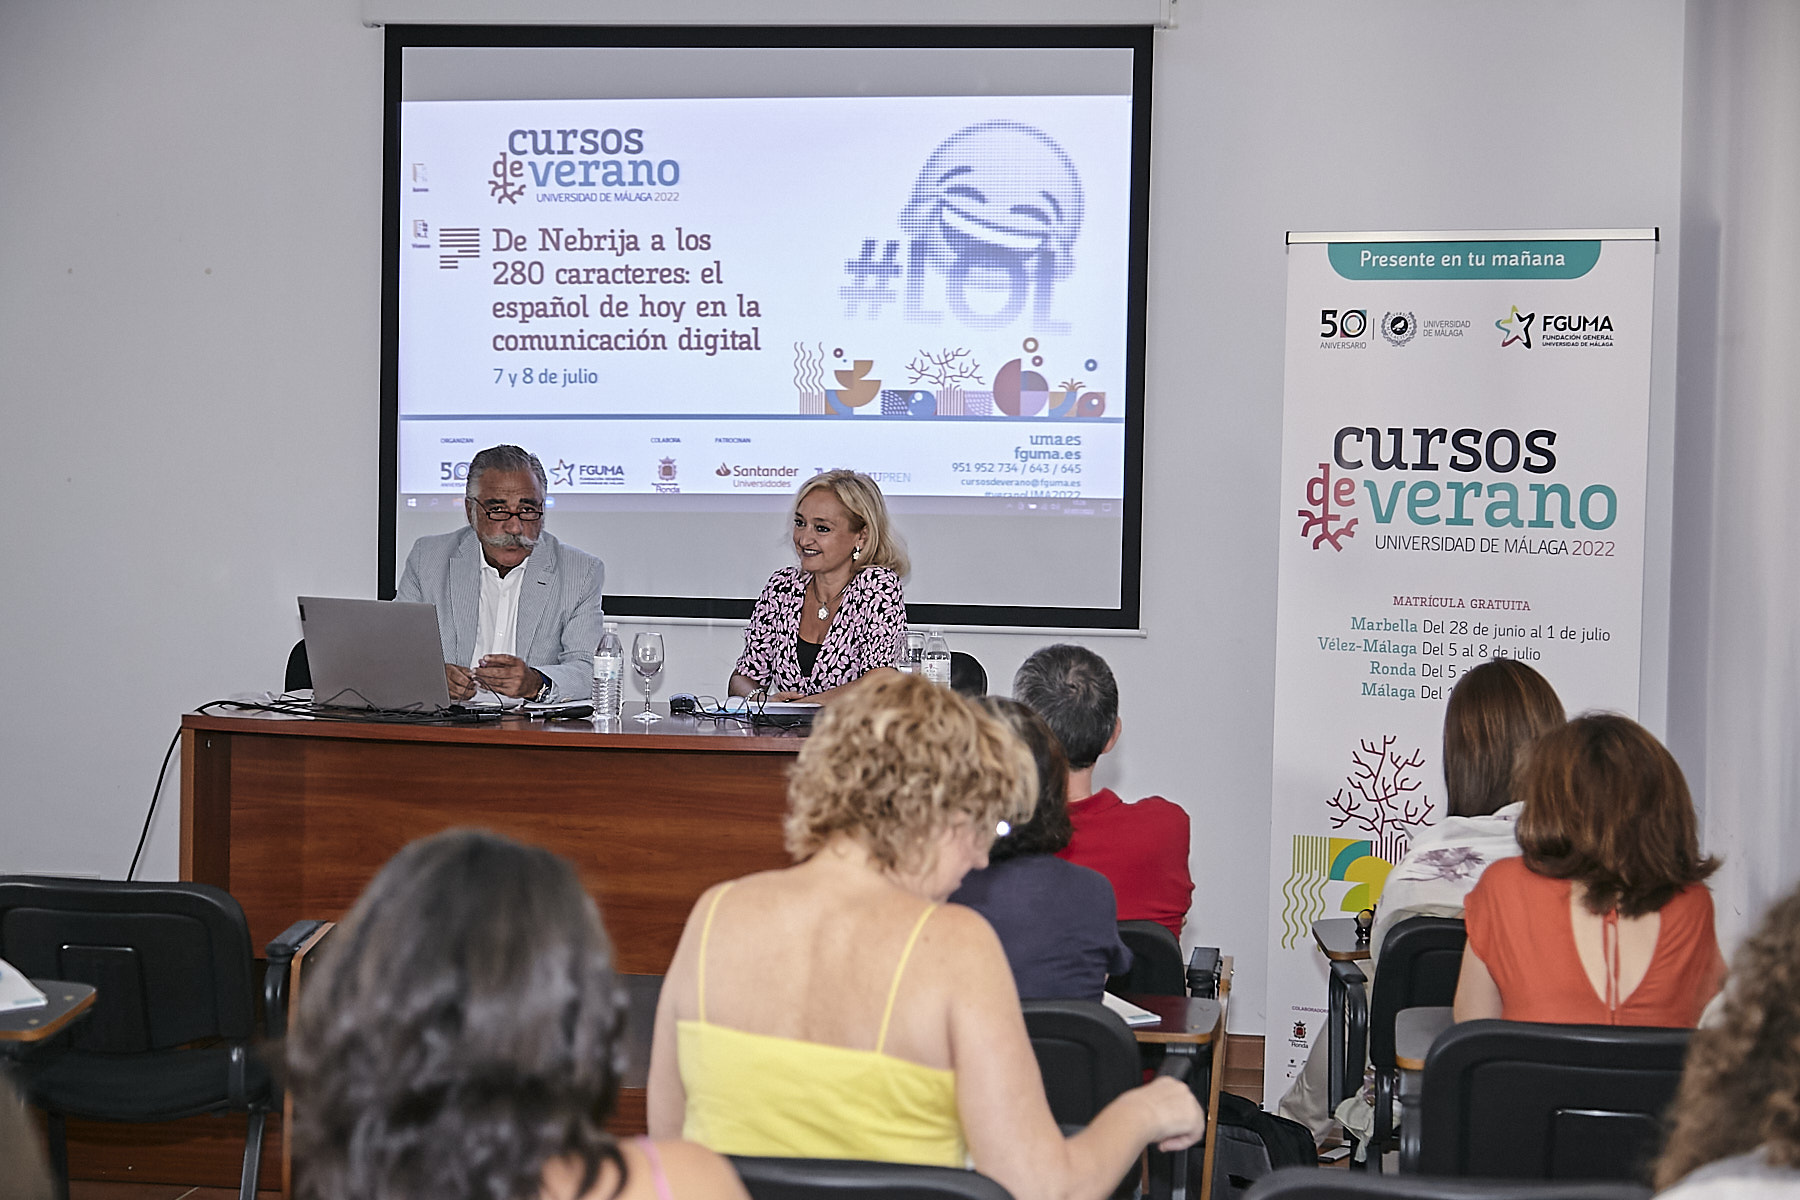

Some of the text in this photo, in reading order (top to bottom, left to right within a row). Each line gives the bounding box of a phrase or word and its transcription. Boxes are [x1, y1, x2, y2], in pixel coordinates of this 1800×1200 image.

[508, 128, 644, 156] cursos
[493, 152, 680, 187] de verano
[536, 191, 679, 202] UNIVERSIDAD DE MÁLAGA 2022
[493, 227, 712, 257] De Nebrija a los
[1360, 250, 1566, 267] Presente en tu mañana
[493, 260, 723, 285] 280 caracteres: el
[492, 294, 762, 323] español de hoy en la
[1320, 309, 1367, 338] 50
[1423, 320, 1471, 328] UNIVERSIDAD
[1543, 315, 1614, 331] FGUMA
[492, 327, 762, 356] comunicación digital
[1434, 328, 1463, 337] MÁLAGA
[1320, 341, 1367, 350] ANIVERSARIO
[493, 367, 598, 388] 7 y 8 de julio
[1014, 447, 1081, 462] fguma.es
[1333, 426, 1558, 474] cursos
[579, 465, 624, 476] FGUMA
[733, 465, 799, 477] Santander
[952, 462, 971, 473] 951
[974, 462, 994, 473] 952
[998, 463, 1018, 473] 734
[1029, 463, 1049, 473] 643
[1061, 464, 1081, 473] 645
[733, 479, 791, 488] Universidades
[961, 478, 1081, 488] cursosdeverano@fguma.es
[1306, 463, 1618, 531] de verano
[1375, 535, 1615, 557] UNIVERSIDAD DE MÁLAGA 2022
[1393, 595, 1531, 611] MATRÍCULA GRATUITA
[1350, 616, 1611, 643] Marbella Del 28 de junio al 1 de julio
[1317, 636, 1541, 660] Vélez-Málaga Del 5 al 8 de julio
[1369, 660, 1417, 676] Ronda
[1421, 663, 1443, 678] Del
[1448, 664, 1457, 678] 5
[1361, 682, 1416, 701] Málaga
[1421, 685, 1442, 700] Del
